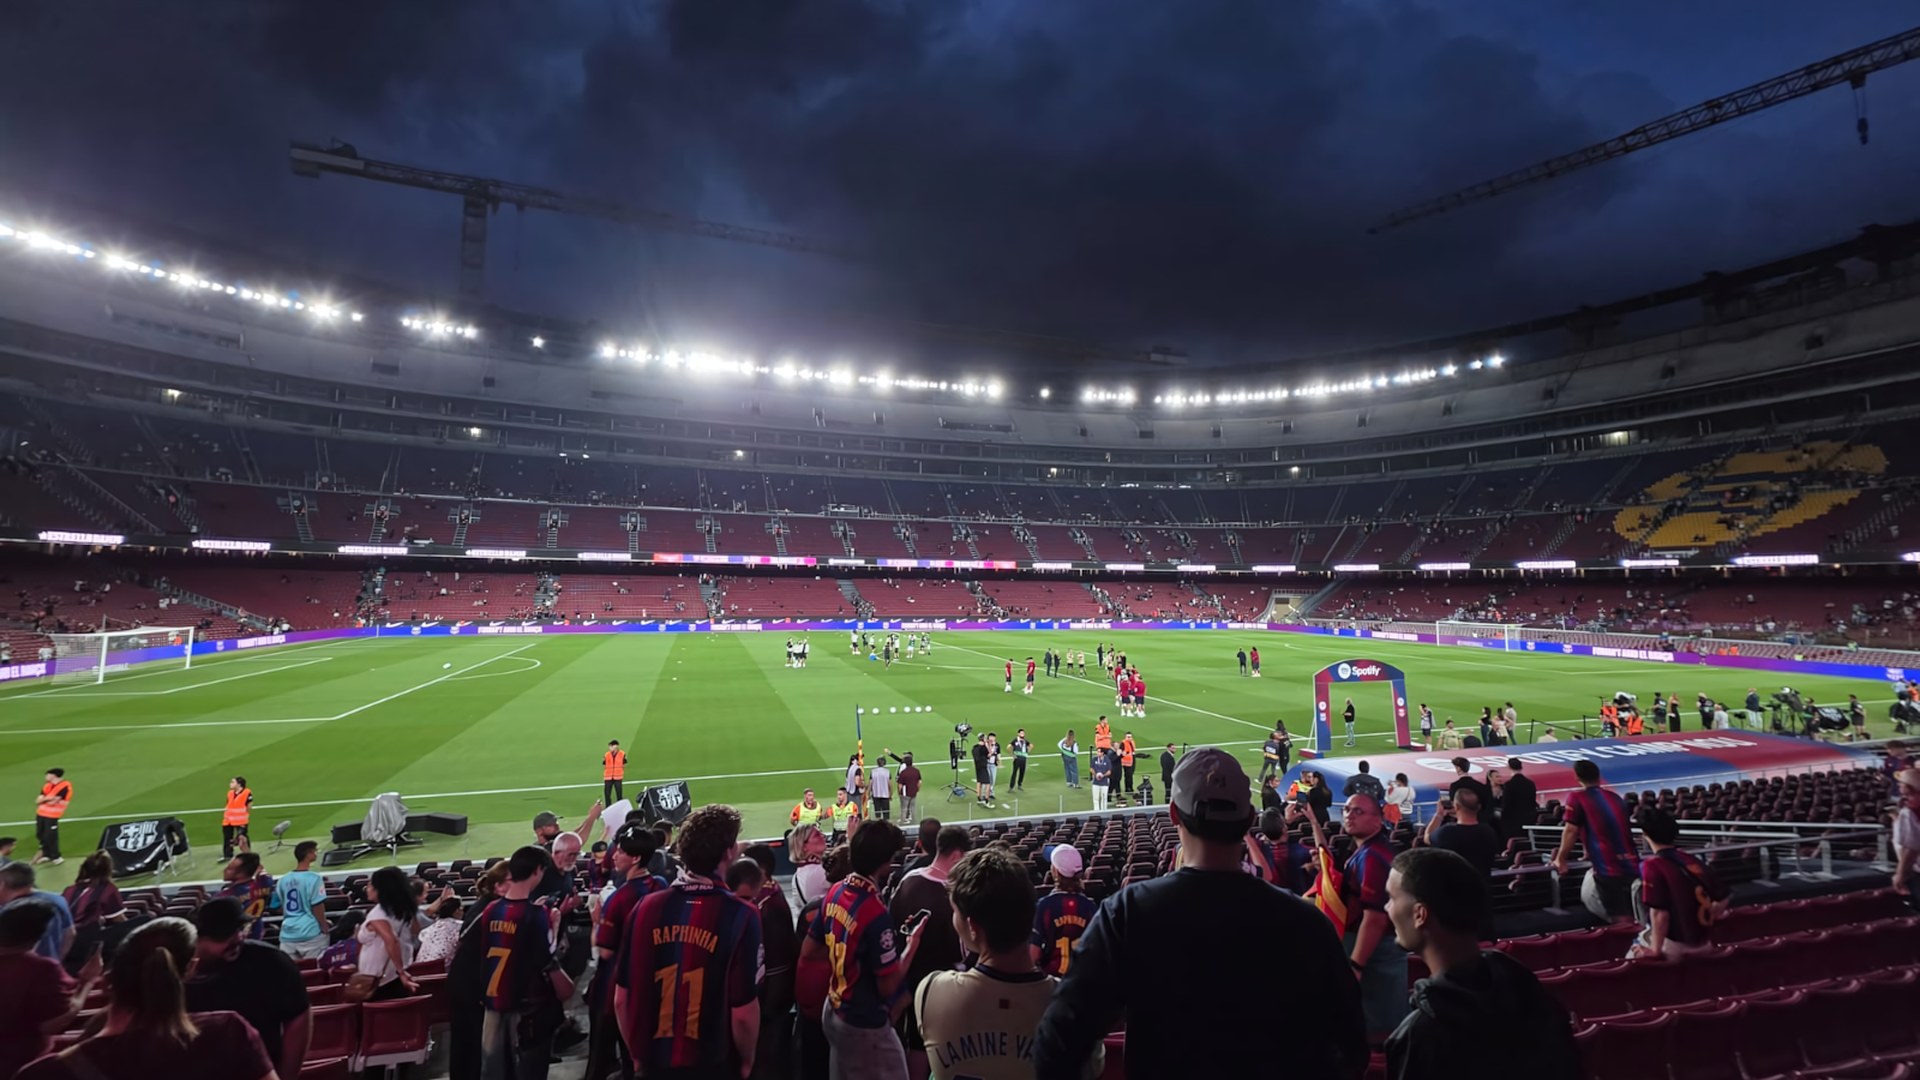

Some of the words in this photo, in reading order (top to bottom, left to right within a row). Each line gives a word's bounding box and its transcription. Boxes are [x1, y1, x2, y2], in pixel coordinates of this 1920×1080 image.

[1352, 664, 1381, 677] Spotify
[286, 887, 300, 912] 8
[652, 924, 719, 953] RAPHINHA
[486, 946, 512, 997] 7
[652, 962, 704, 1040] 11
[935, 1031, 1008, 1069] LAMINE
